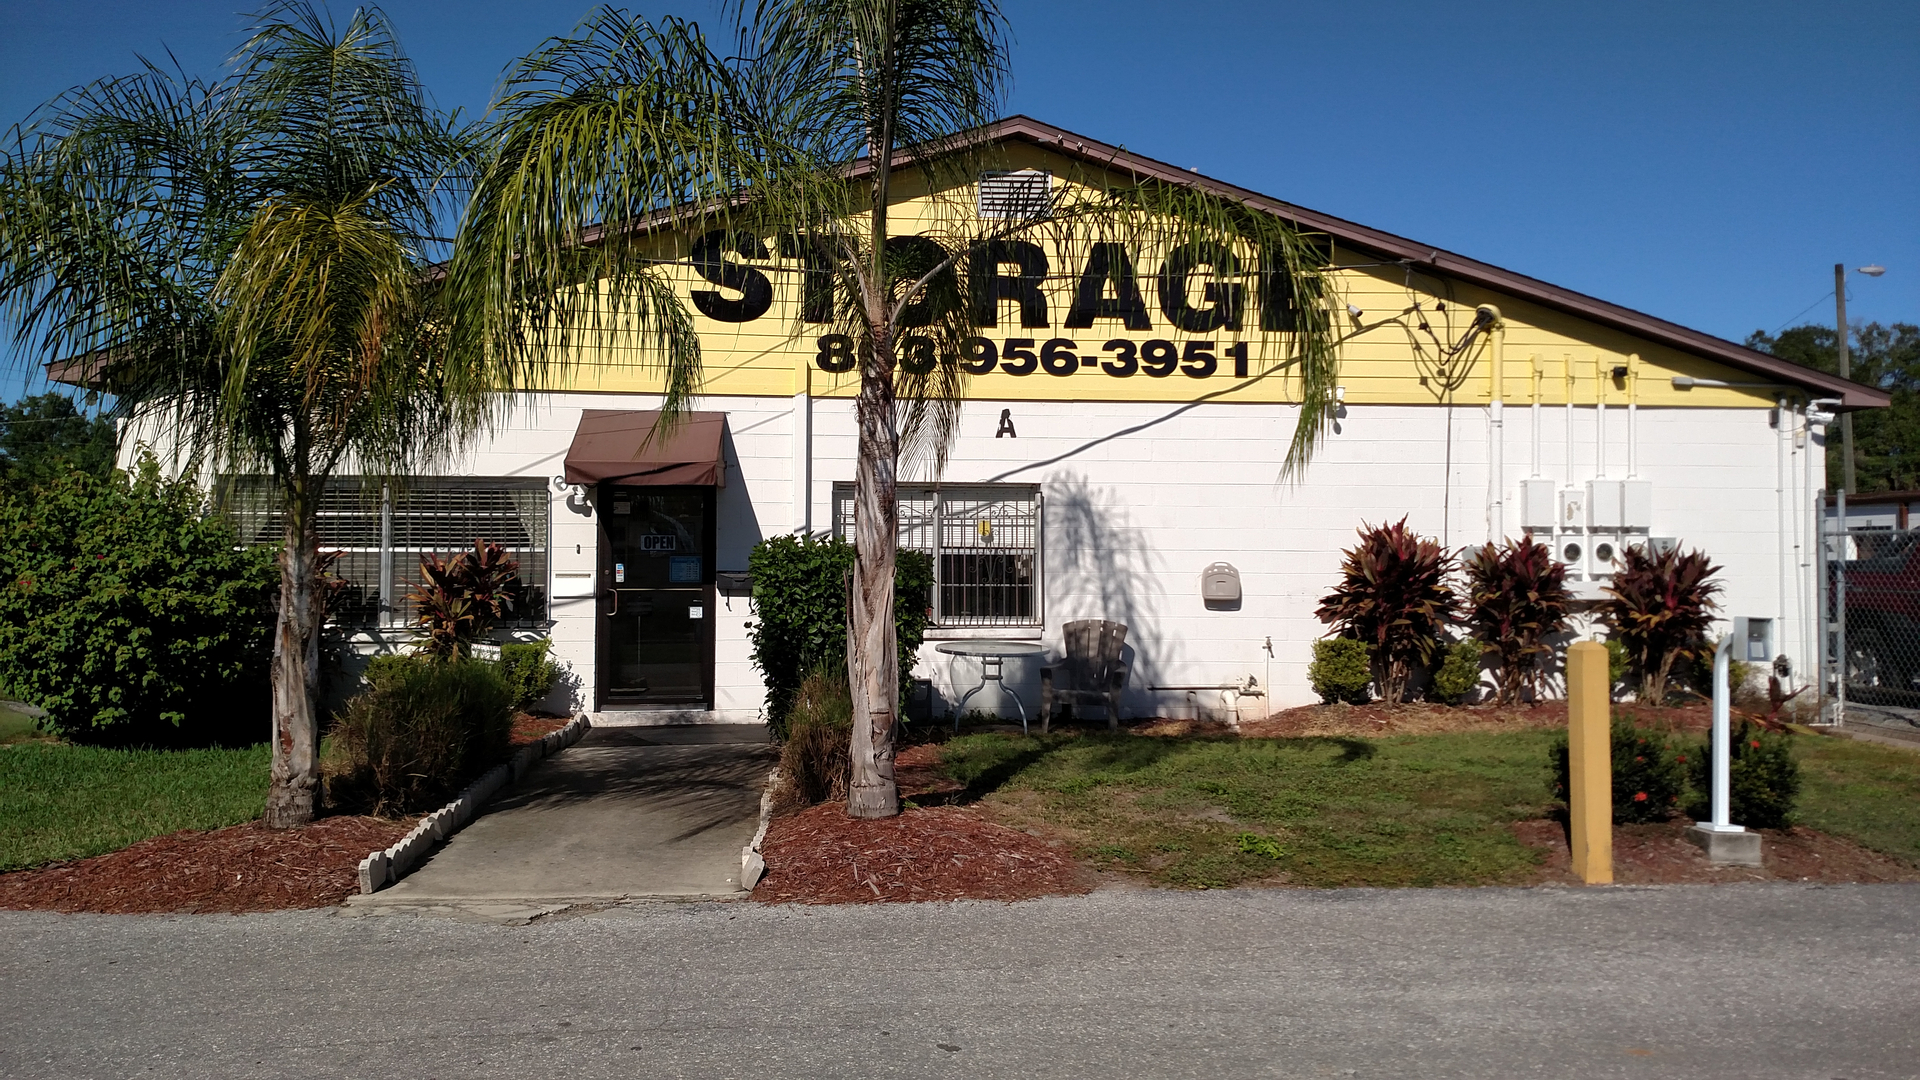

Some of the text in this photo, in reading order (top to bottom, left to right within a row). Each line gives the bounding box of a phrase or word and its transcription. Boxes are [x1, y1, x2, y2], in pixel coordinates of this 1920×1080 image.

[816, 333, 1248, 378] 83-956-3951
[996, 408, 1016, 438] A
[644, 536, 674, 549] OPEN
